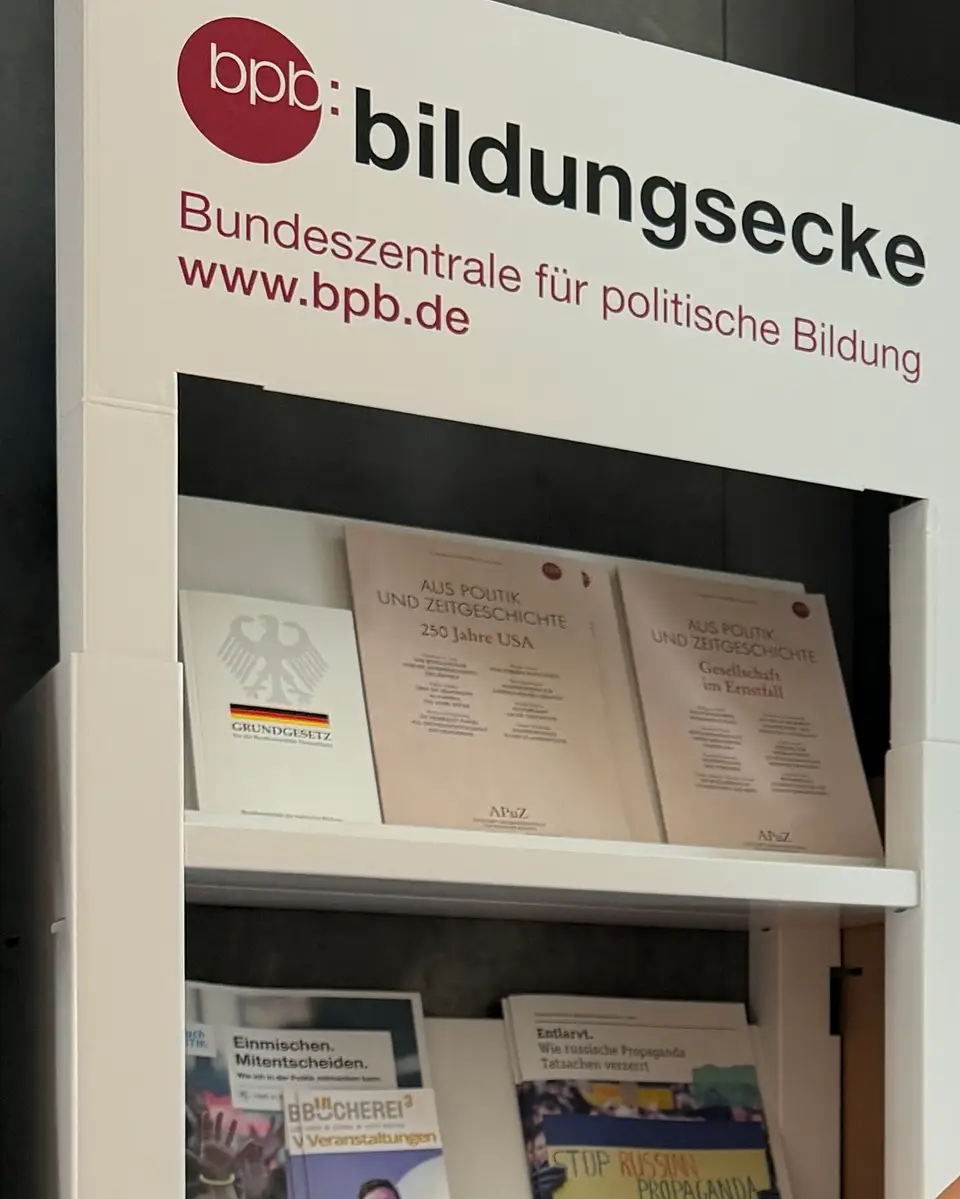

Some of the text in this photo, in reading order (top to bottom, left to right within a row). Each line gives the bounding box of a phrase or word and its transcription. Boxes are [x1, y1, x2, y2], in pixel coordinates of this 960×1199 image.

[354, 87, 927, 288] bildungsecke
[178, 255, 471, 335] www.bpb.de
[179, 190, 923, 384] Bundeszentrale für politische Bildung
[421, 579, 521, 604] AUS POLITIK
[377, 590, 568, 629] UND ZEITGESCHICHTE
[420, 623, 535, 649] 250 Jahre USA
[687, 619, 775, 641] AUS POLITIK
[651, 629, 818, 663] UND ZEITGESCHICHTE
[698, 661, 782, 682] Gesellschaft
[702, 679, 784, 699] im Ernstfall
[231, 722, 332, 742] GRUNDGESETZ
[233, 1035, 336, 1053] Einmischen.
[536, 1028, 594, 1040] Entlarvt.
[538, 1042, 563, 1055] Wie
[235, 1054, 369, 1070] Mitentscheiden.
[306, 1130, 437, 1148] Veranstaltungen
[618, 1152, 699, 1179] RUSSIAN
